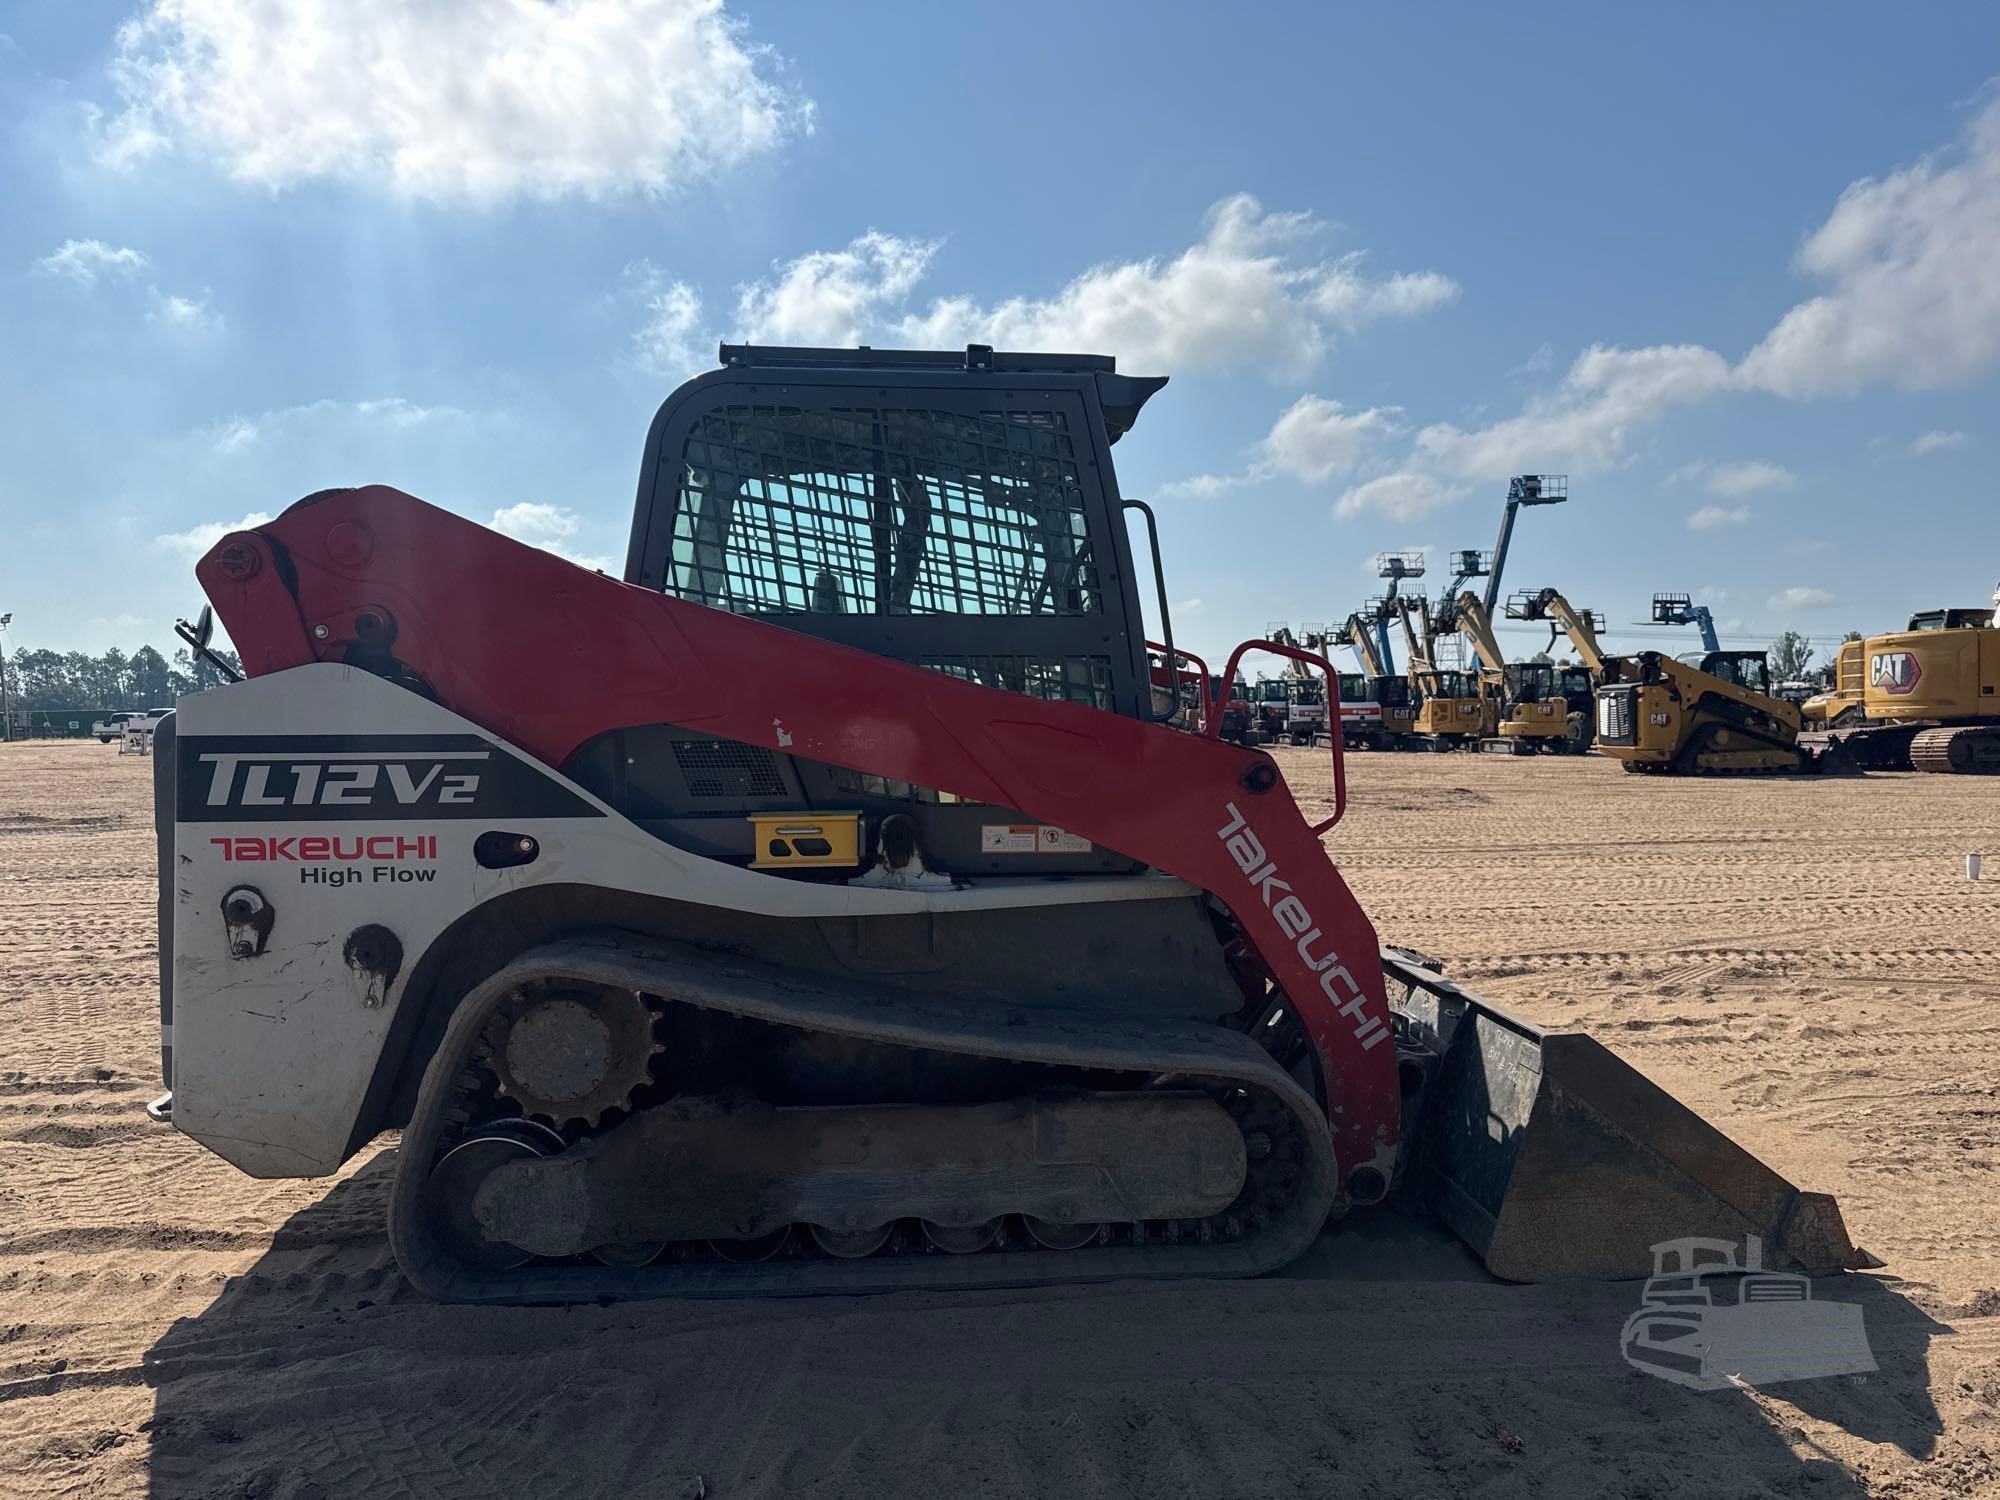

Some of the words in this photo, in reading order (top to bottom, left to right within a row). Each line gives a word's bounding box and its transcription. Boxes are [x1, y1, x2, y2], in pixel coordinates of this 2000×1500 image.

[1871, 653, 1906, 687] CAT
[1393, 709, 1410, 720] CAT
[1458, 704, 1473, 713] CAT
[1537, 705, 1551, 714] CAT
[1650, 713, 1668, 725] CAT
[199, 751, 490, 806] TL12V2
[210, 835, 437, 862] TAKEUCHI
[300, 867, 364, 888] High
[373, 866, 437, 883] Flow
